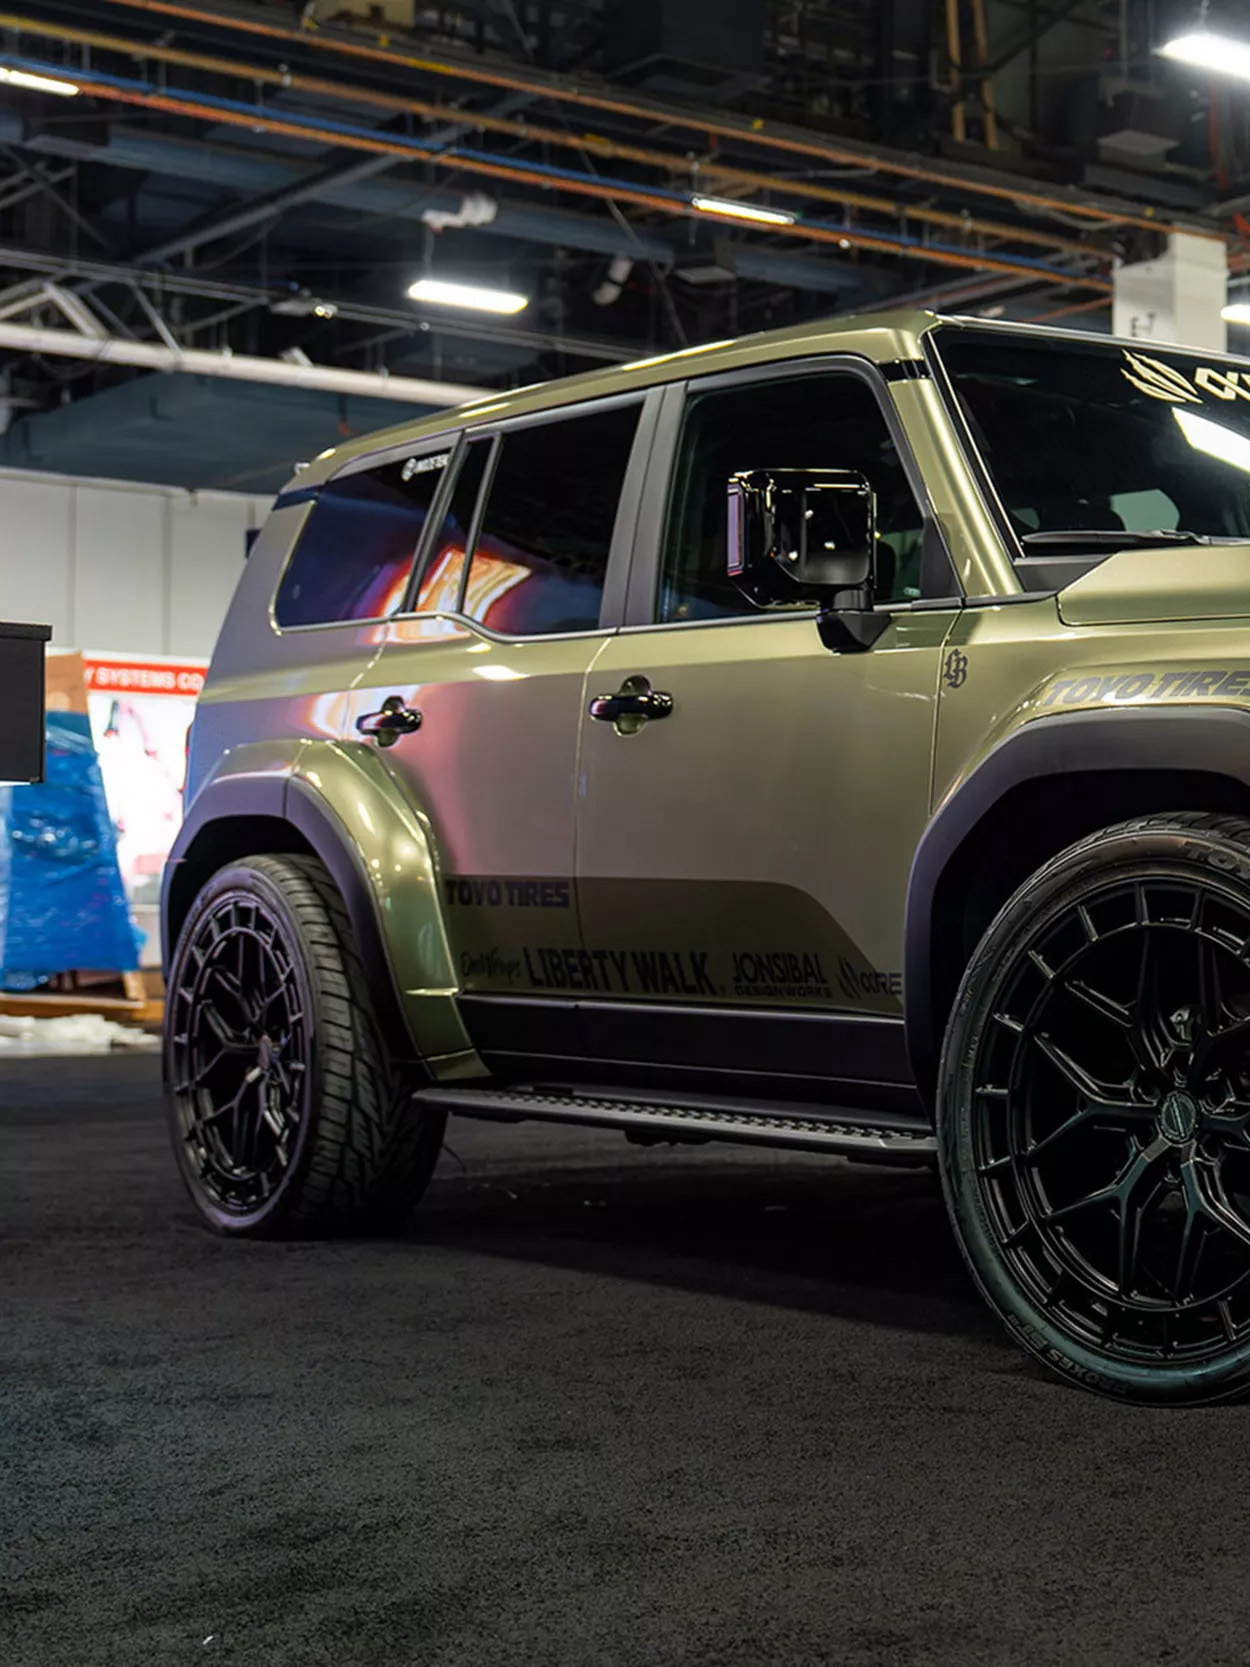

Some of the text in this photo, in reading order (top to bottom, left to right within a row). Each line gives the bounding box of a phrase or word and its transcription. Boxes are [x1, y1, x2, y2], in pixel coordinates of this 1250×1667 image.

[95, 667, 176, 690] SYSTEMS
[1045, 676, 1154, 706] TOYO
[444, 880, 570, 908] TOYO TIRES
[522, 947, 629, 993] LIBERTY
[630, 950, 717, 996] WALK
[732, 952, 829, 985] JONSIBAL
